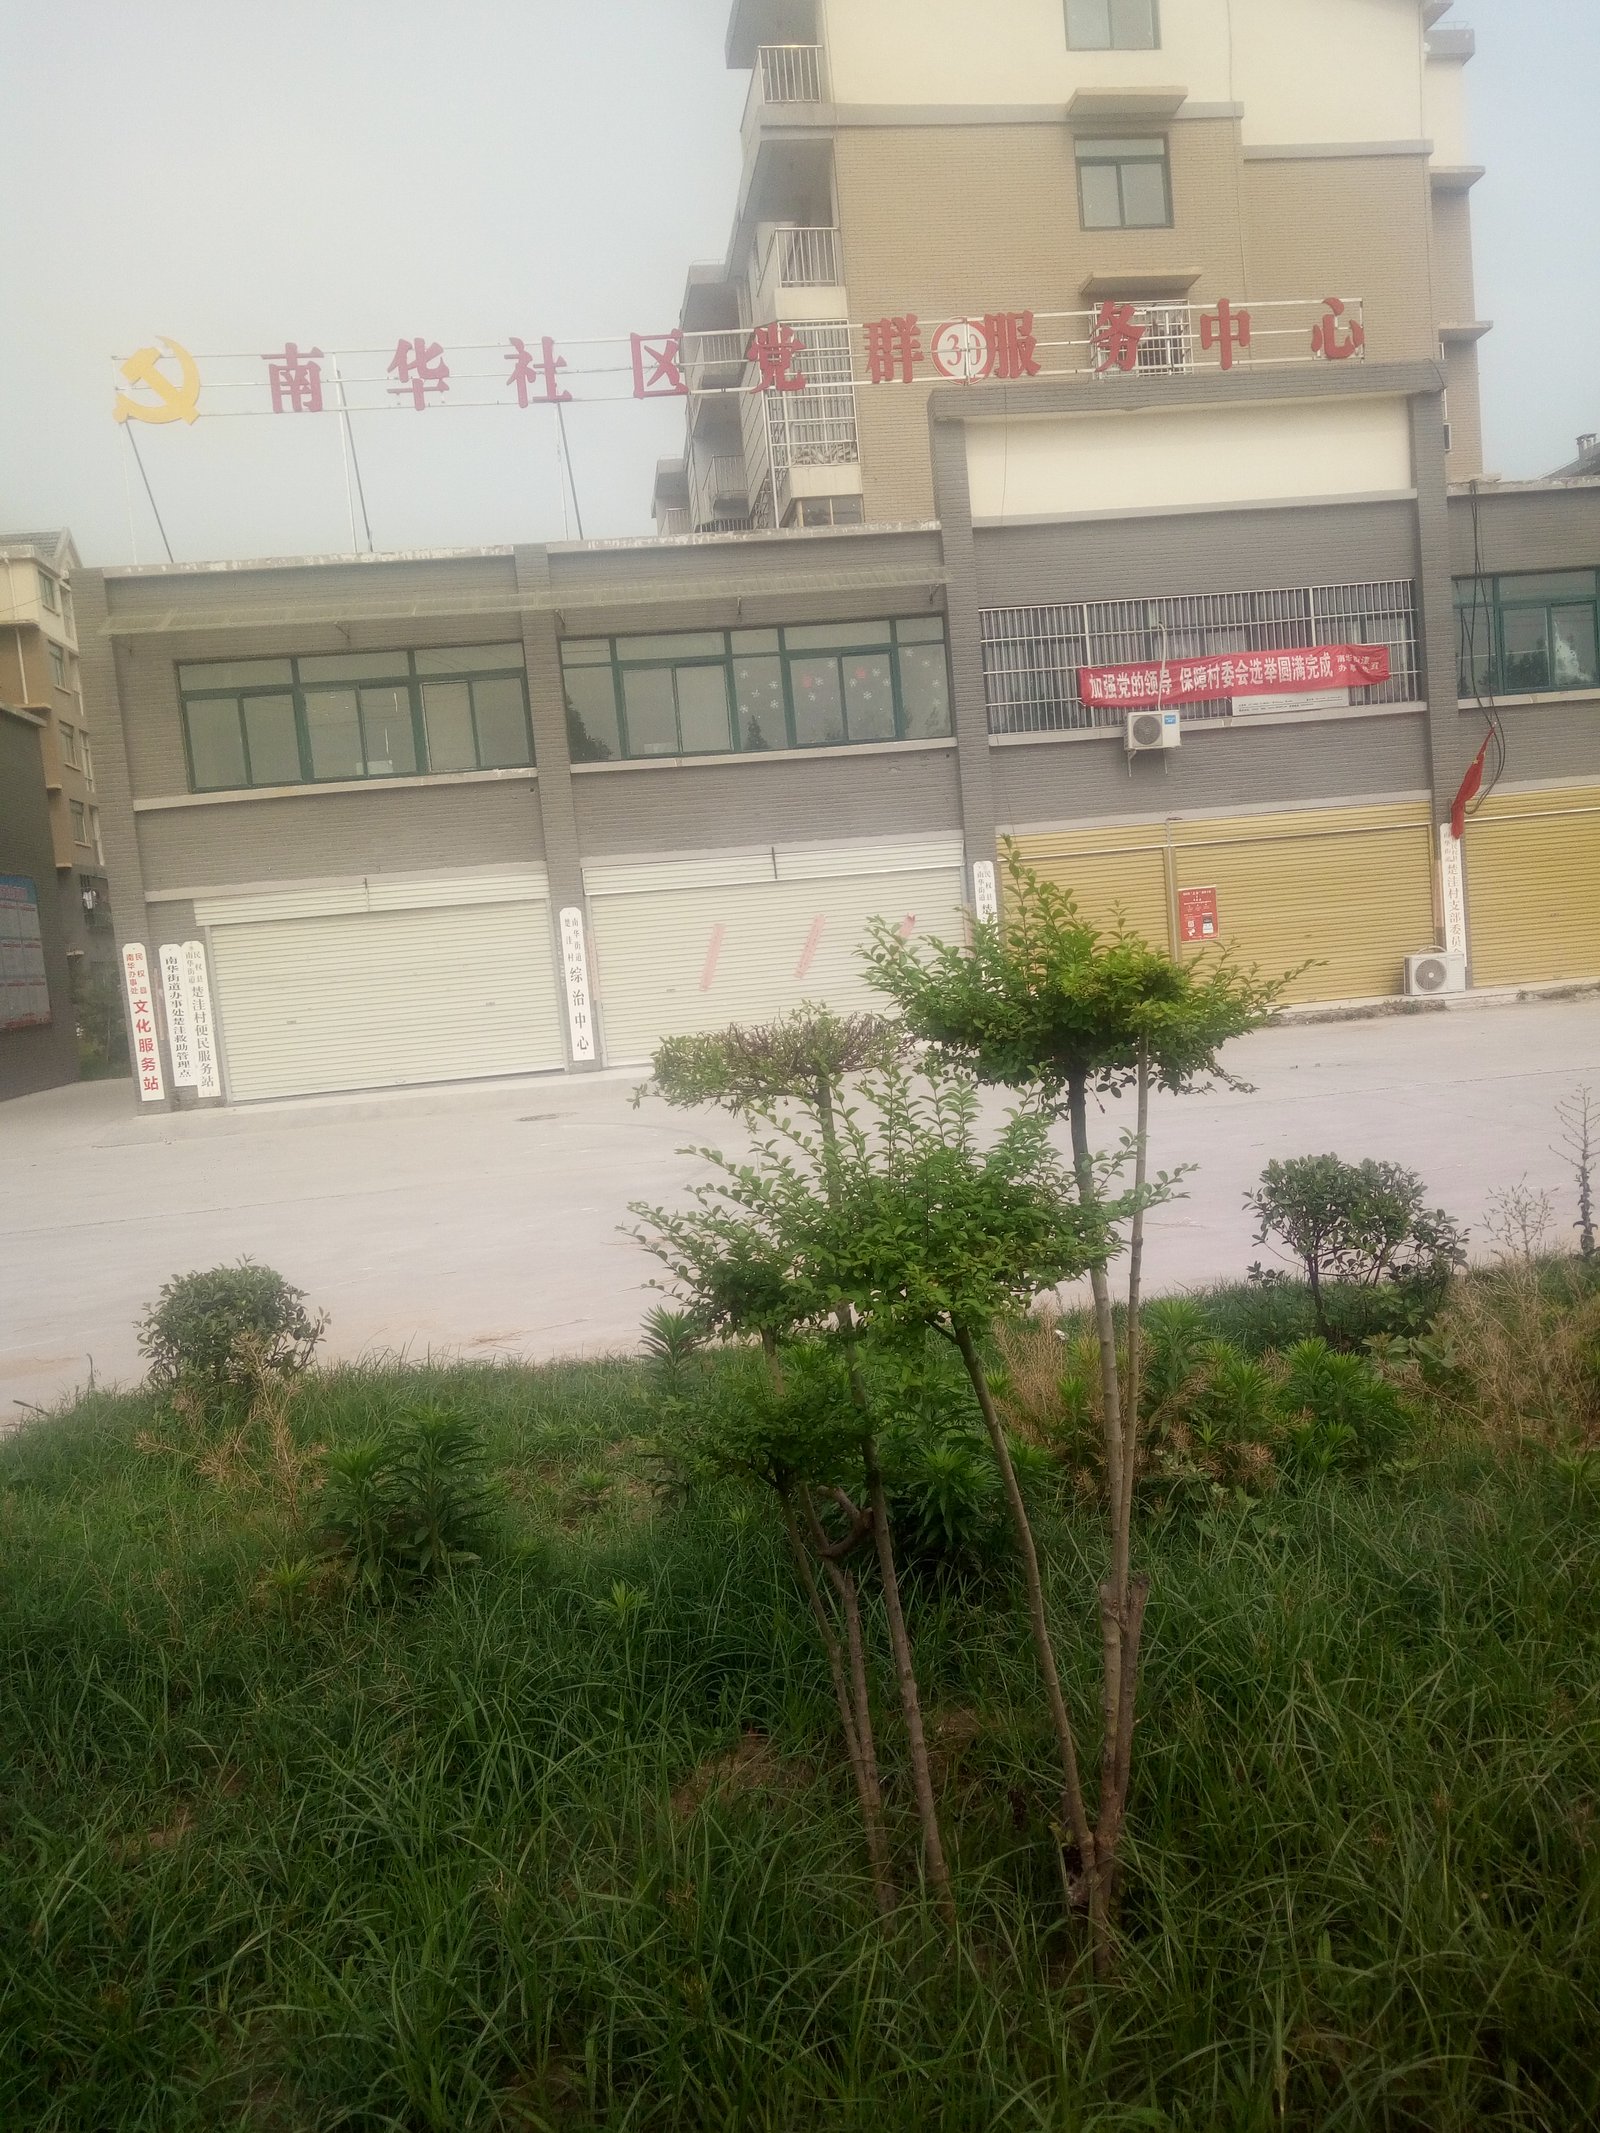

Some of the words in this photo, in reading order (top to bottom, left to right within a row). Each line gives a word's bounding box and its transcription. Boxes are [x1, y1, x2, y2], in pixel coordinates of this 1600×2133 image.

[260, 297, 1365, 414] 南华社区党群服务中心
[1090, 668, 1174, 700] 加强党的领导
[1179, 652, 1335, 693] 保障村委会选举圆满完成
[126, 953, 138, 995] 南华办事处
[135, 952, 148, 995] 民权县
[569, 966, 590, 1051] 综治中心
[133, 999, 160, 1091] 文化服务站
